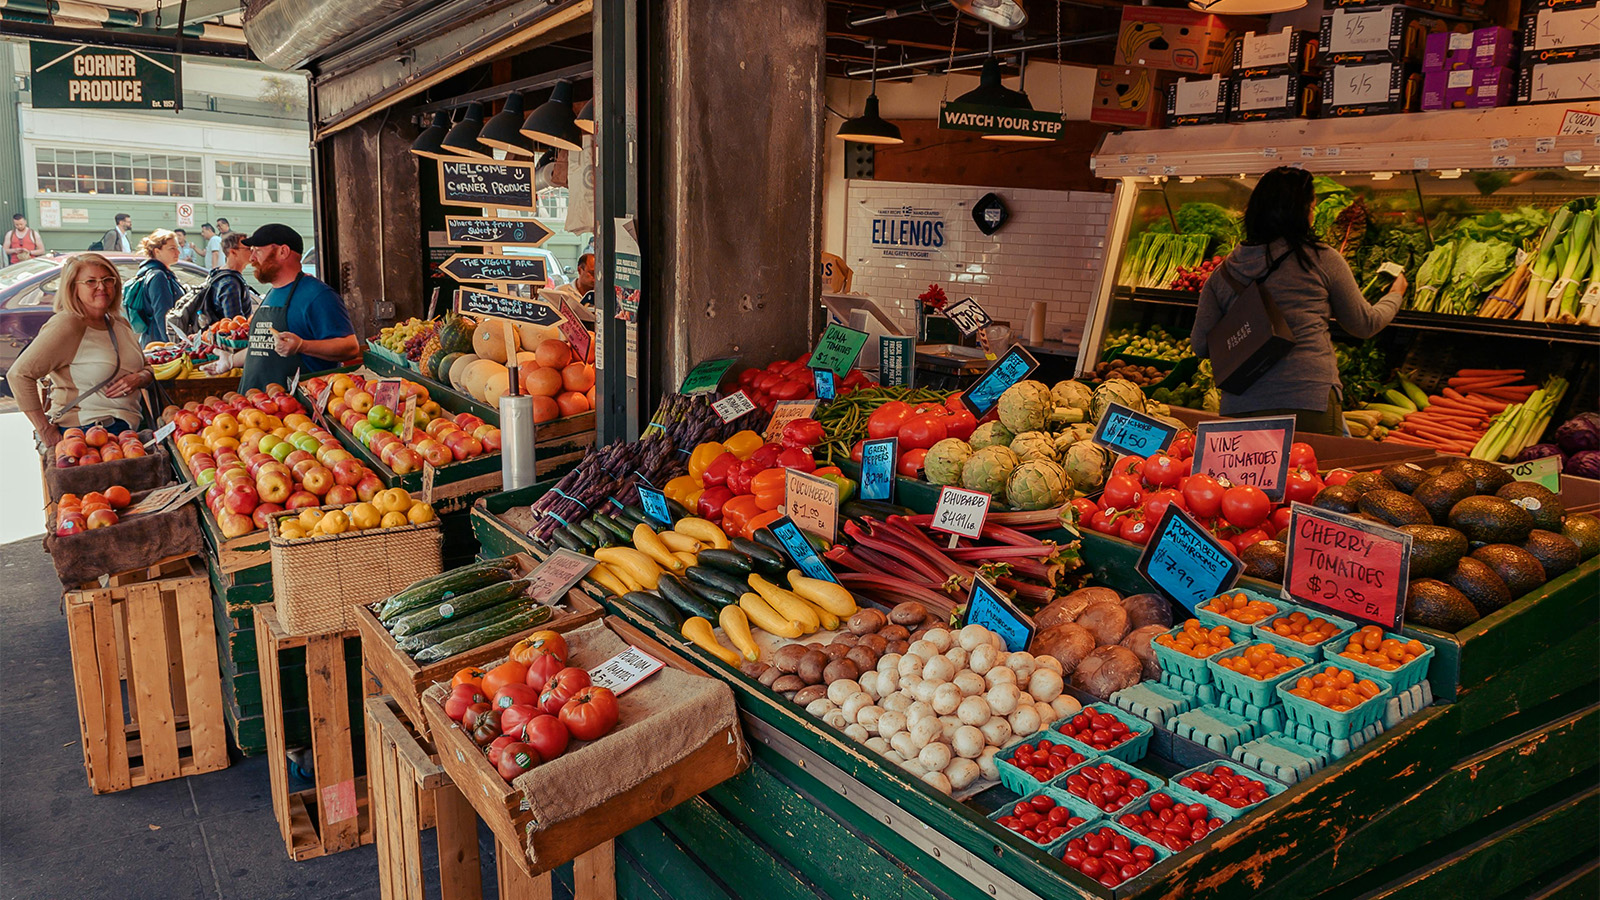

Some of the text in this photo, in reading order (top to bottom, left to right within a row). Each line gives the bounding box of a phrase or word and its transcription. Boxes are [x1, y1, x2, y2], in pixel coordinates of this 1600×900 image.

[1345, 15, 1372, 39] 5/5
[73, 54, 136, 77] CORNER
[68, 79, 143, 102] PRODUCE
[1349, 72, 1374, 96] 5/5
[944, 111, 1062, 134] WATCH YOUR STEP
[1568, 112, 1598, 127] CORN
[491, 181, 531, 195] PRODUCE
[872, 219, 944, 248] ELLENOS
[460, 258, 480, 267] THE
[826, 327, 848, 344] ROMA
[867, 444, 888, 456] GREEN
[1209, 434, 1243, 453] VINE
[863, 453, 890, 466] PEPPERS
[1218, 450, 1279, 469] TOMATOES
[790, 476, 834, 506] CUCUMBERS
[942, 490, 986, 508] RHUBARB
[1172, 517, 1229, 570] PORTABELLO
[1300, 518, 1375, 558] CHERRY
[1164, 530, 1218, 573] MUSHROOMS
[1303, 546, 1385, 589] TOMATOES
